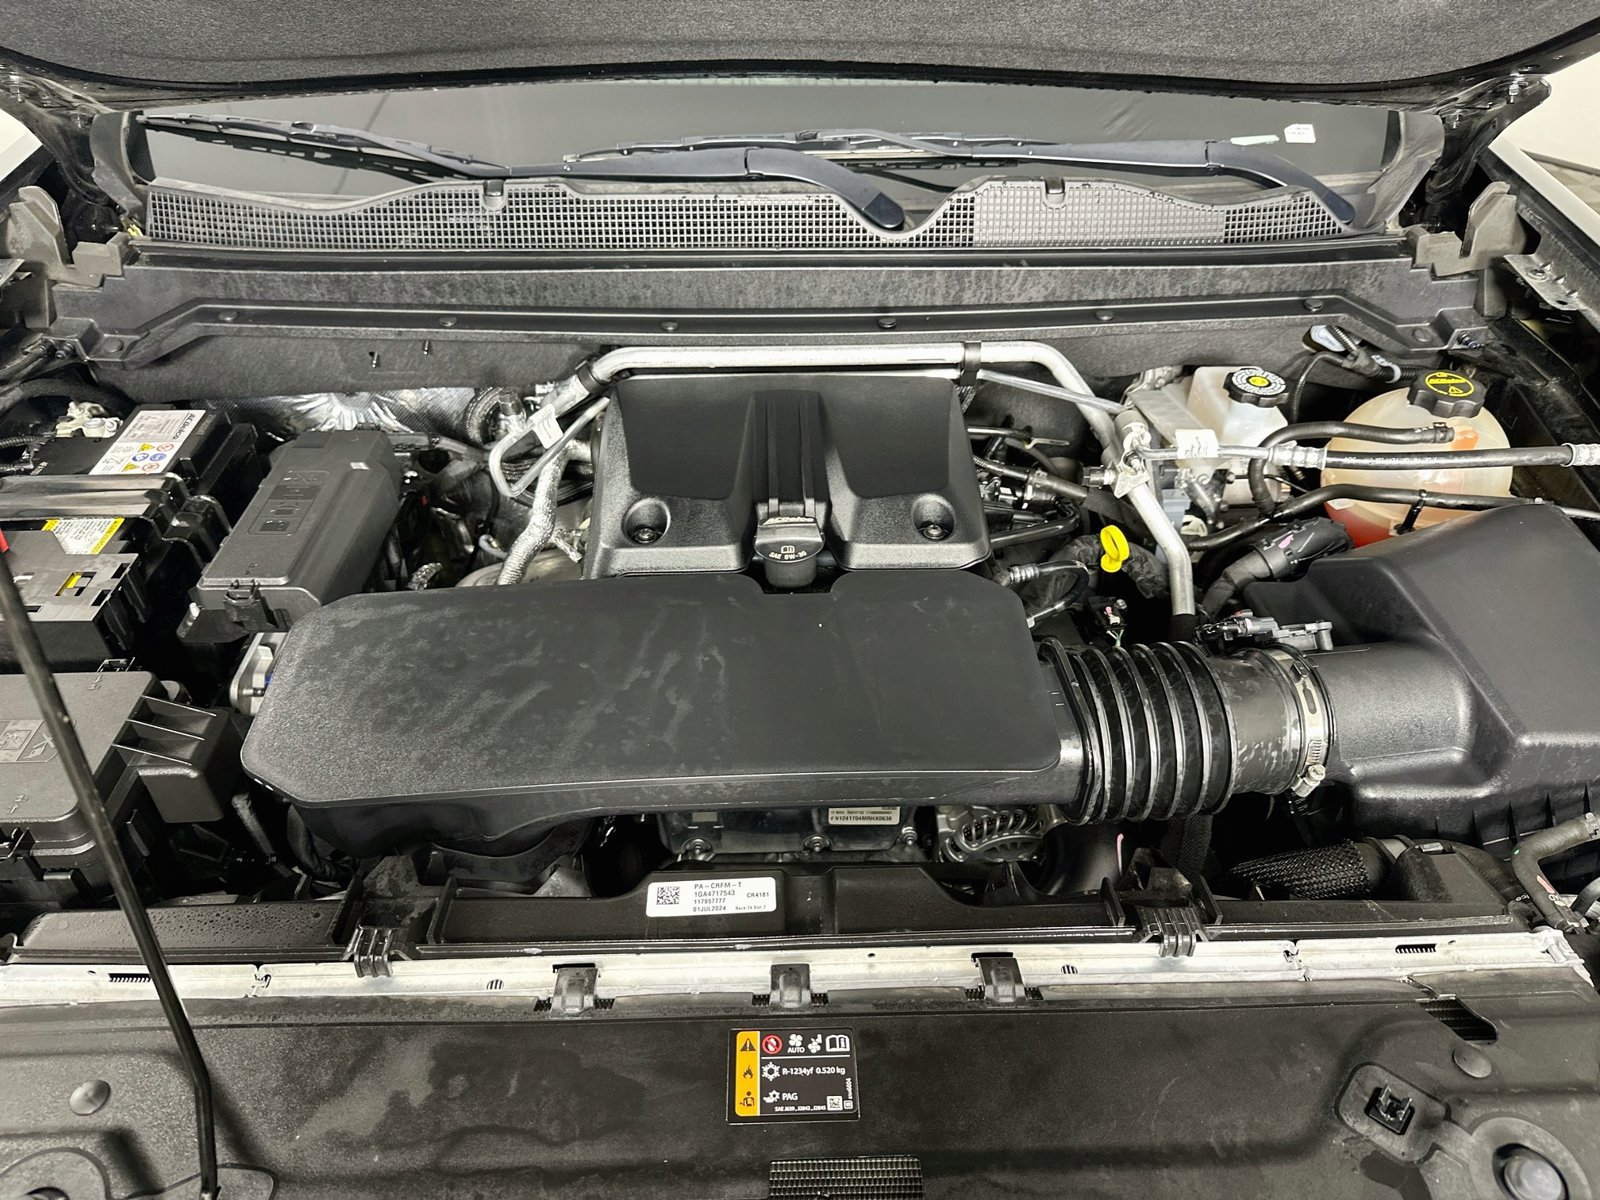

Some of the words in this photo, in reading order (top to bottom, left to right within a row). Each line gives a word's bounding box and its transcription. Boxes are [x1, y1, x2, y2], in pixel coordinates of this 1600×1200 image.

[173, 413, 196, 440] ACDelco
[694, 889, 735, 898] 1GA4717543
[782, 1067, 814, 1076] R-1234yf
[836, 1067, 846, 1075] kg
[782, 1092, 798, 1101] PAG
